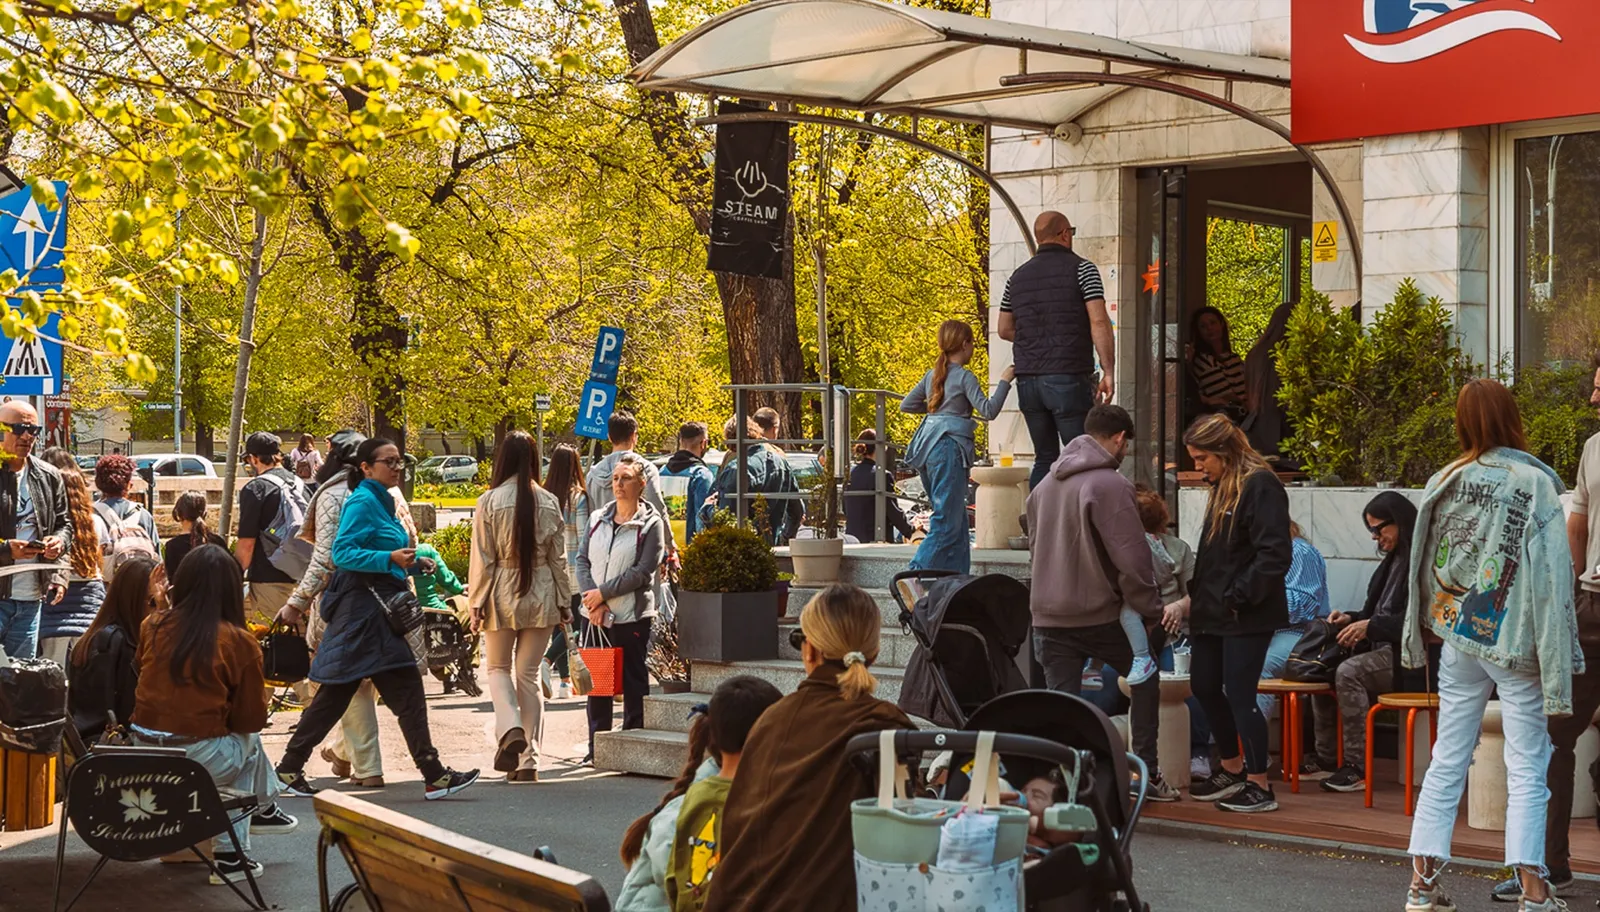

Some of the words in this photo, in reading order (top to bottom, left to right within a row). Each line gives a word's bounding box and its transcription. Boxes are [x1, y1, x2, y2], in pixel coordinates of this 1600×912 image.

[725, 200, 778, 220] STEAM
[599, 332, 617, 363] P
[586, 388, 607, 419] P
[188, 790, 202, 813] 1
